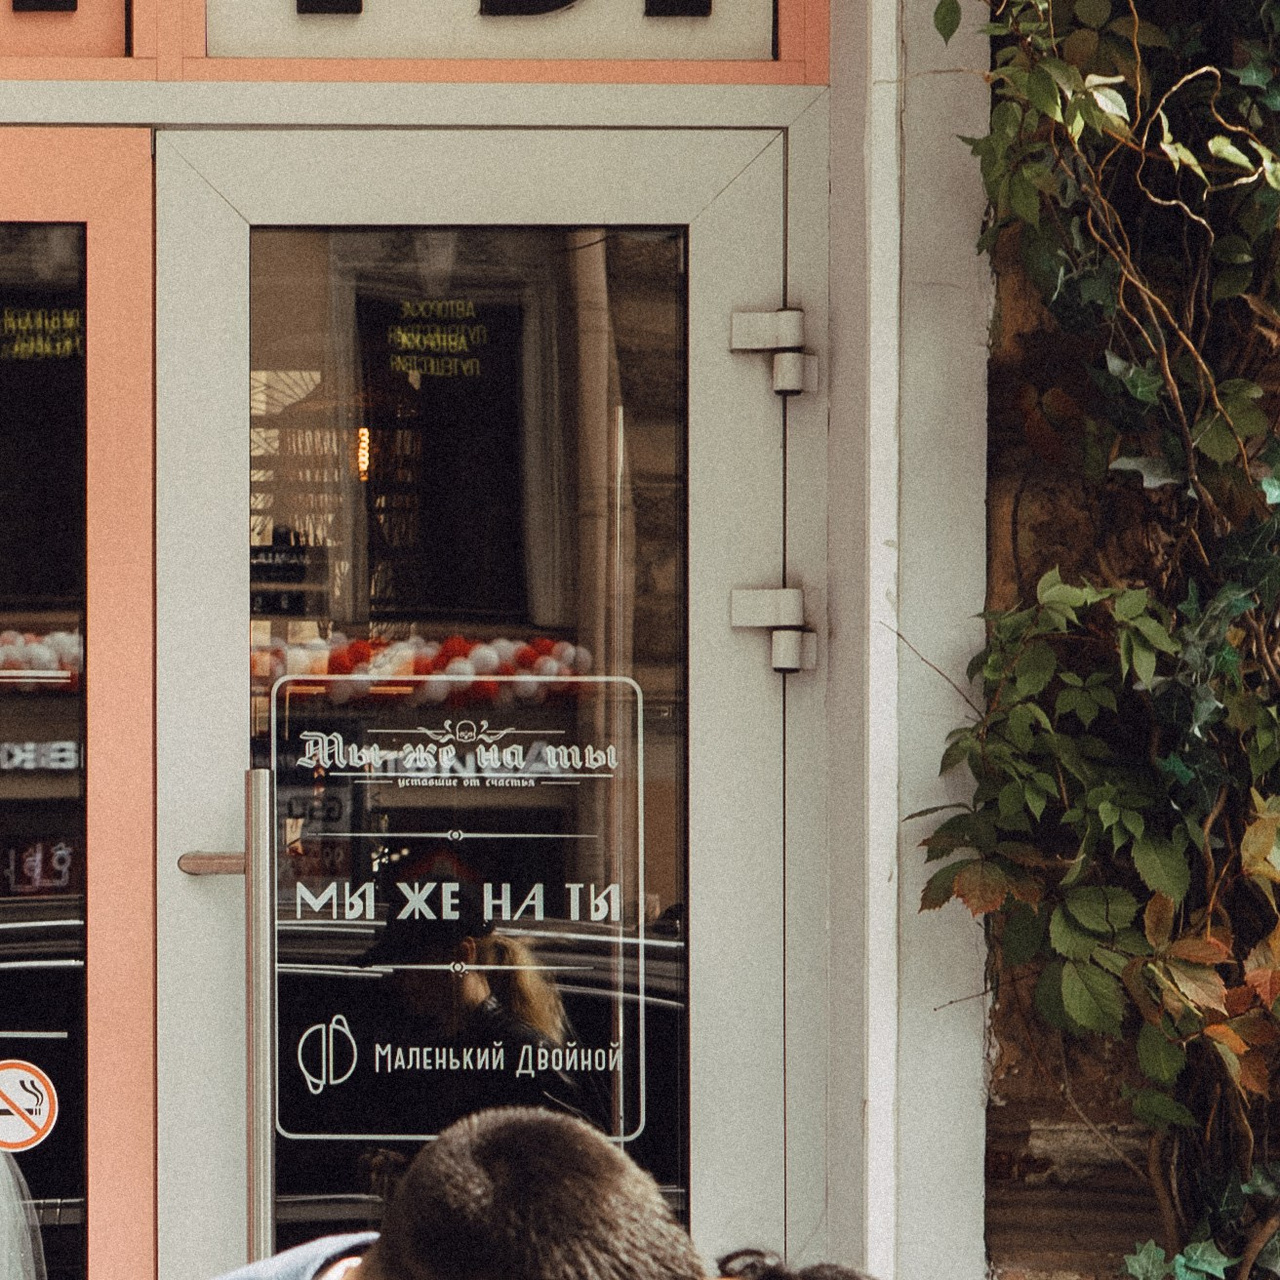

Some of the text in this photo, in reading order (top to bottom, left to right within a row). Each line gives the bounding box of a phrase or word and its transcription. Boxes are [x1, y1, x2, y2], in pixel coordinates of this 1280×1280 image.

[476, 742, 527, 769] на
[546, 743, 619, 770] ты
[463, 778, 481, 787] от
[485, 778, 536, 788] счастья
[296, 881, 620, 921] МЫ ЖЕ НА ТЫ
